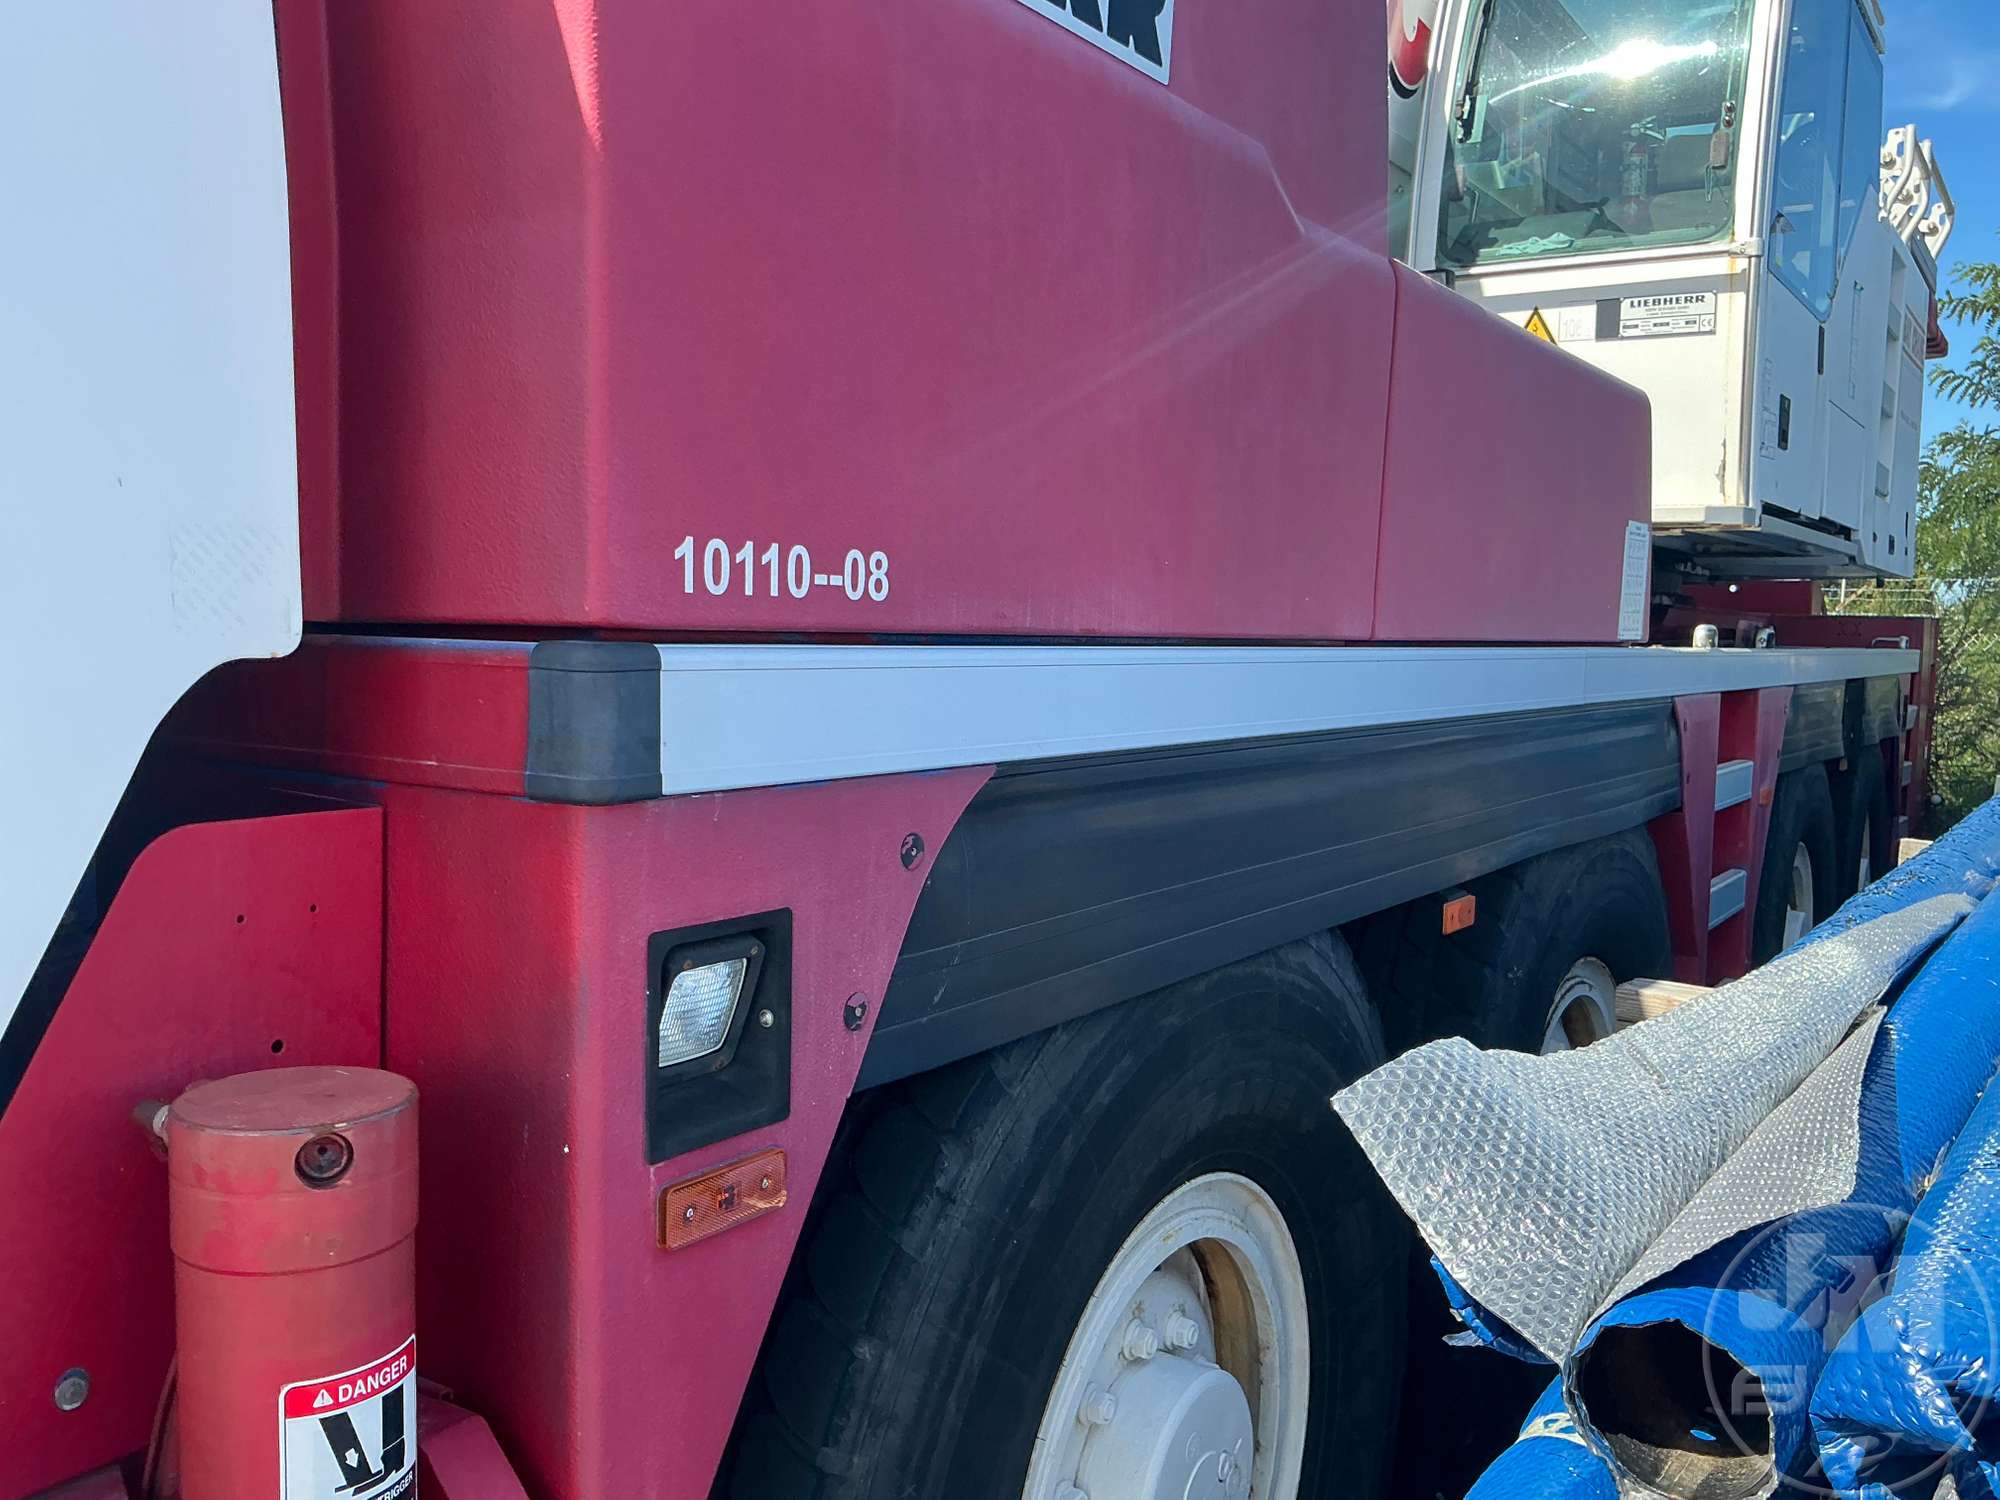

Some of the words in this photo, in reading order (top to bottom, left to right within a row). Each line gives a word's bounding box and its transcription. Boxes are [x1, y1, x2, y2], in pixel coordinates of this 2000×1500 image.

[1630, 295, 1706, 308] LIEBHERR
[674, 535, 889, 601] 10110--08
[338, 1355, 407, 1403] DANGER
